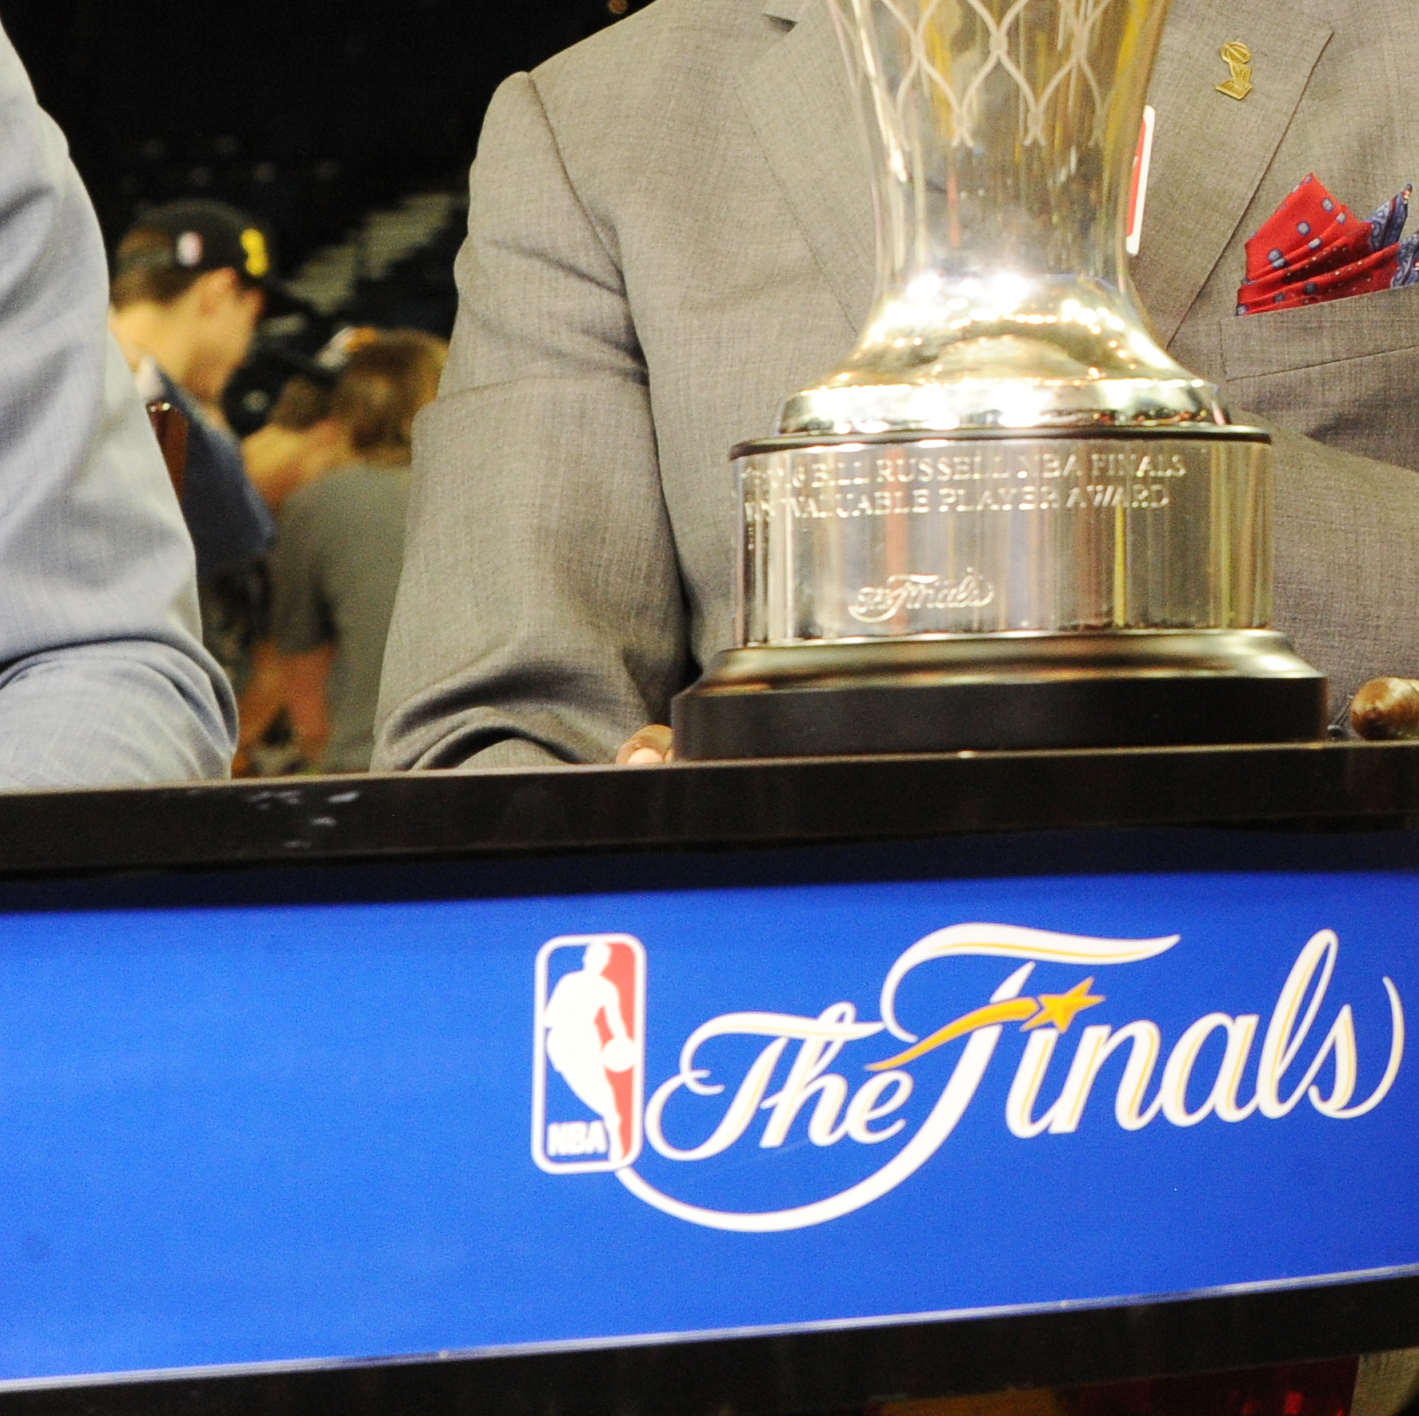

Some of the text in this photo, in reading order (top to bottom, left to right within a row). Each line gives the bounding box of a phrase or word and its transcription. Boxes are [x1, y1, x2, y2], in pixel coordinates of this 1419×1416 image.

[811, 463, 868, 488] BILL
[875, 456, 1010, 484] RUSSELL
[1017, 453, 1083, 479] NBA
[1091, 452, 1187, 478] FINALS
[780, 488, 931, 518] VALUABLE
[937, 485, 1060, 512] PLAYER
[1066, 484, 1170, 509] AWARD
[644, 1001, 914, 1161] The
[547, 1120, 608, 1157] NBA
